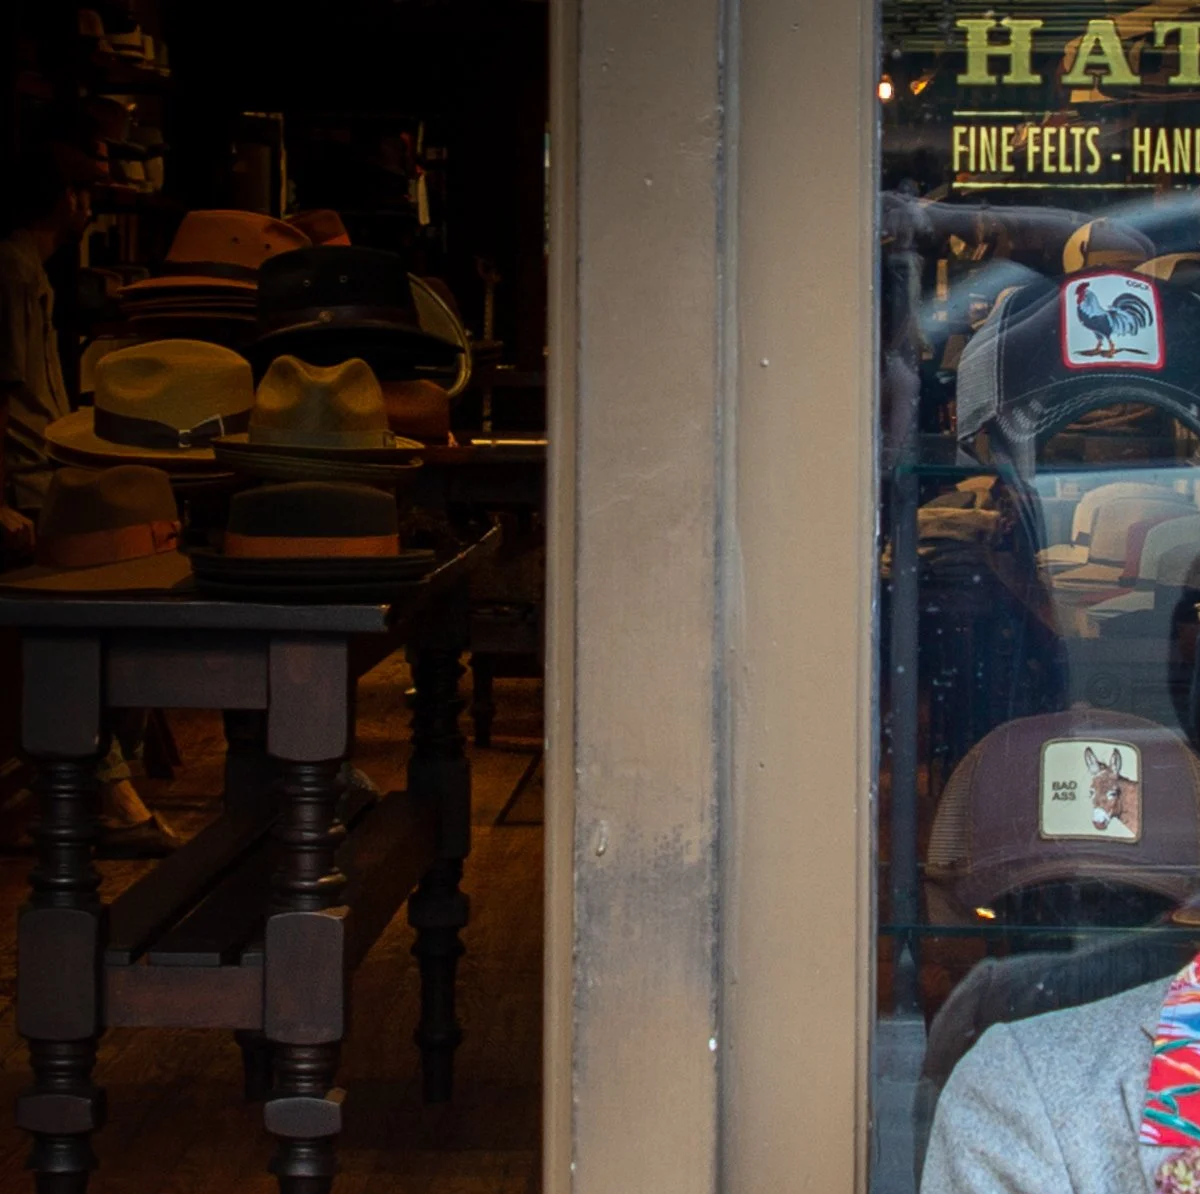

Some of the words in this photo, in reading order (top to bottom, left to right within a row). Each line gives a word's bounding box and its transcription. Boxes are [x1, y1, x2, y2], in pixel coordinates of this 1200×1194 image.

[953, 127, 1015, 172] FINE
[1027, 127, 1100, 173] FELTS
[1052, 780, 1078, 790] BAD
[1052, 791, 1076, 801] ASS
